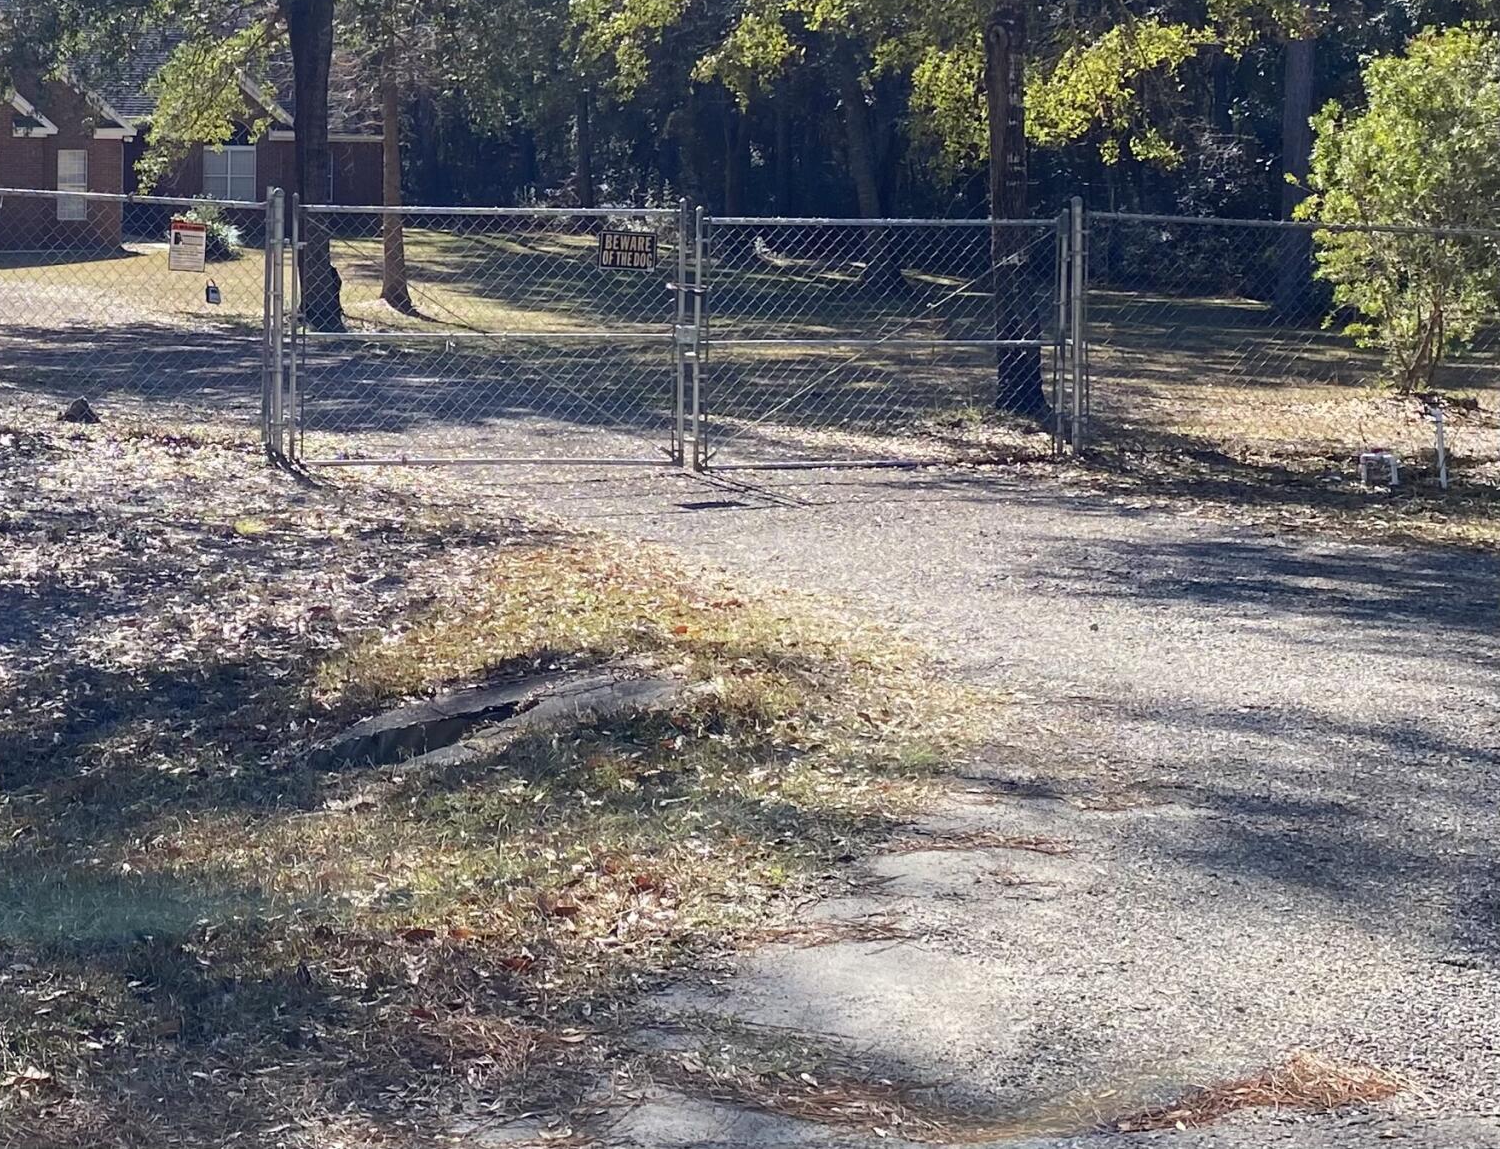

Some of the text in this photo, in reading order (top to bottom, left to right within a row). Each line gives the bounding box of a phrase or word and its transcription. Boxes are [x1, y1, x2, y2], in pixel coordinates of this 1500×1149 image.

[605, 234, 652, 252] BEWARE
[602, 250, 653, 267] OF THE DOG
